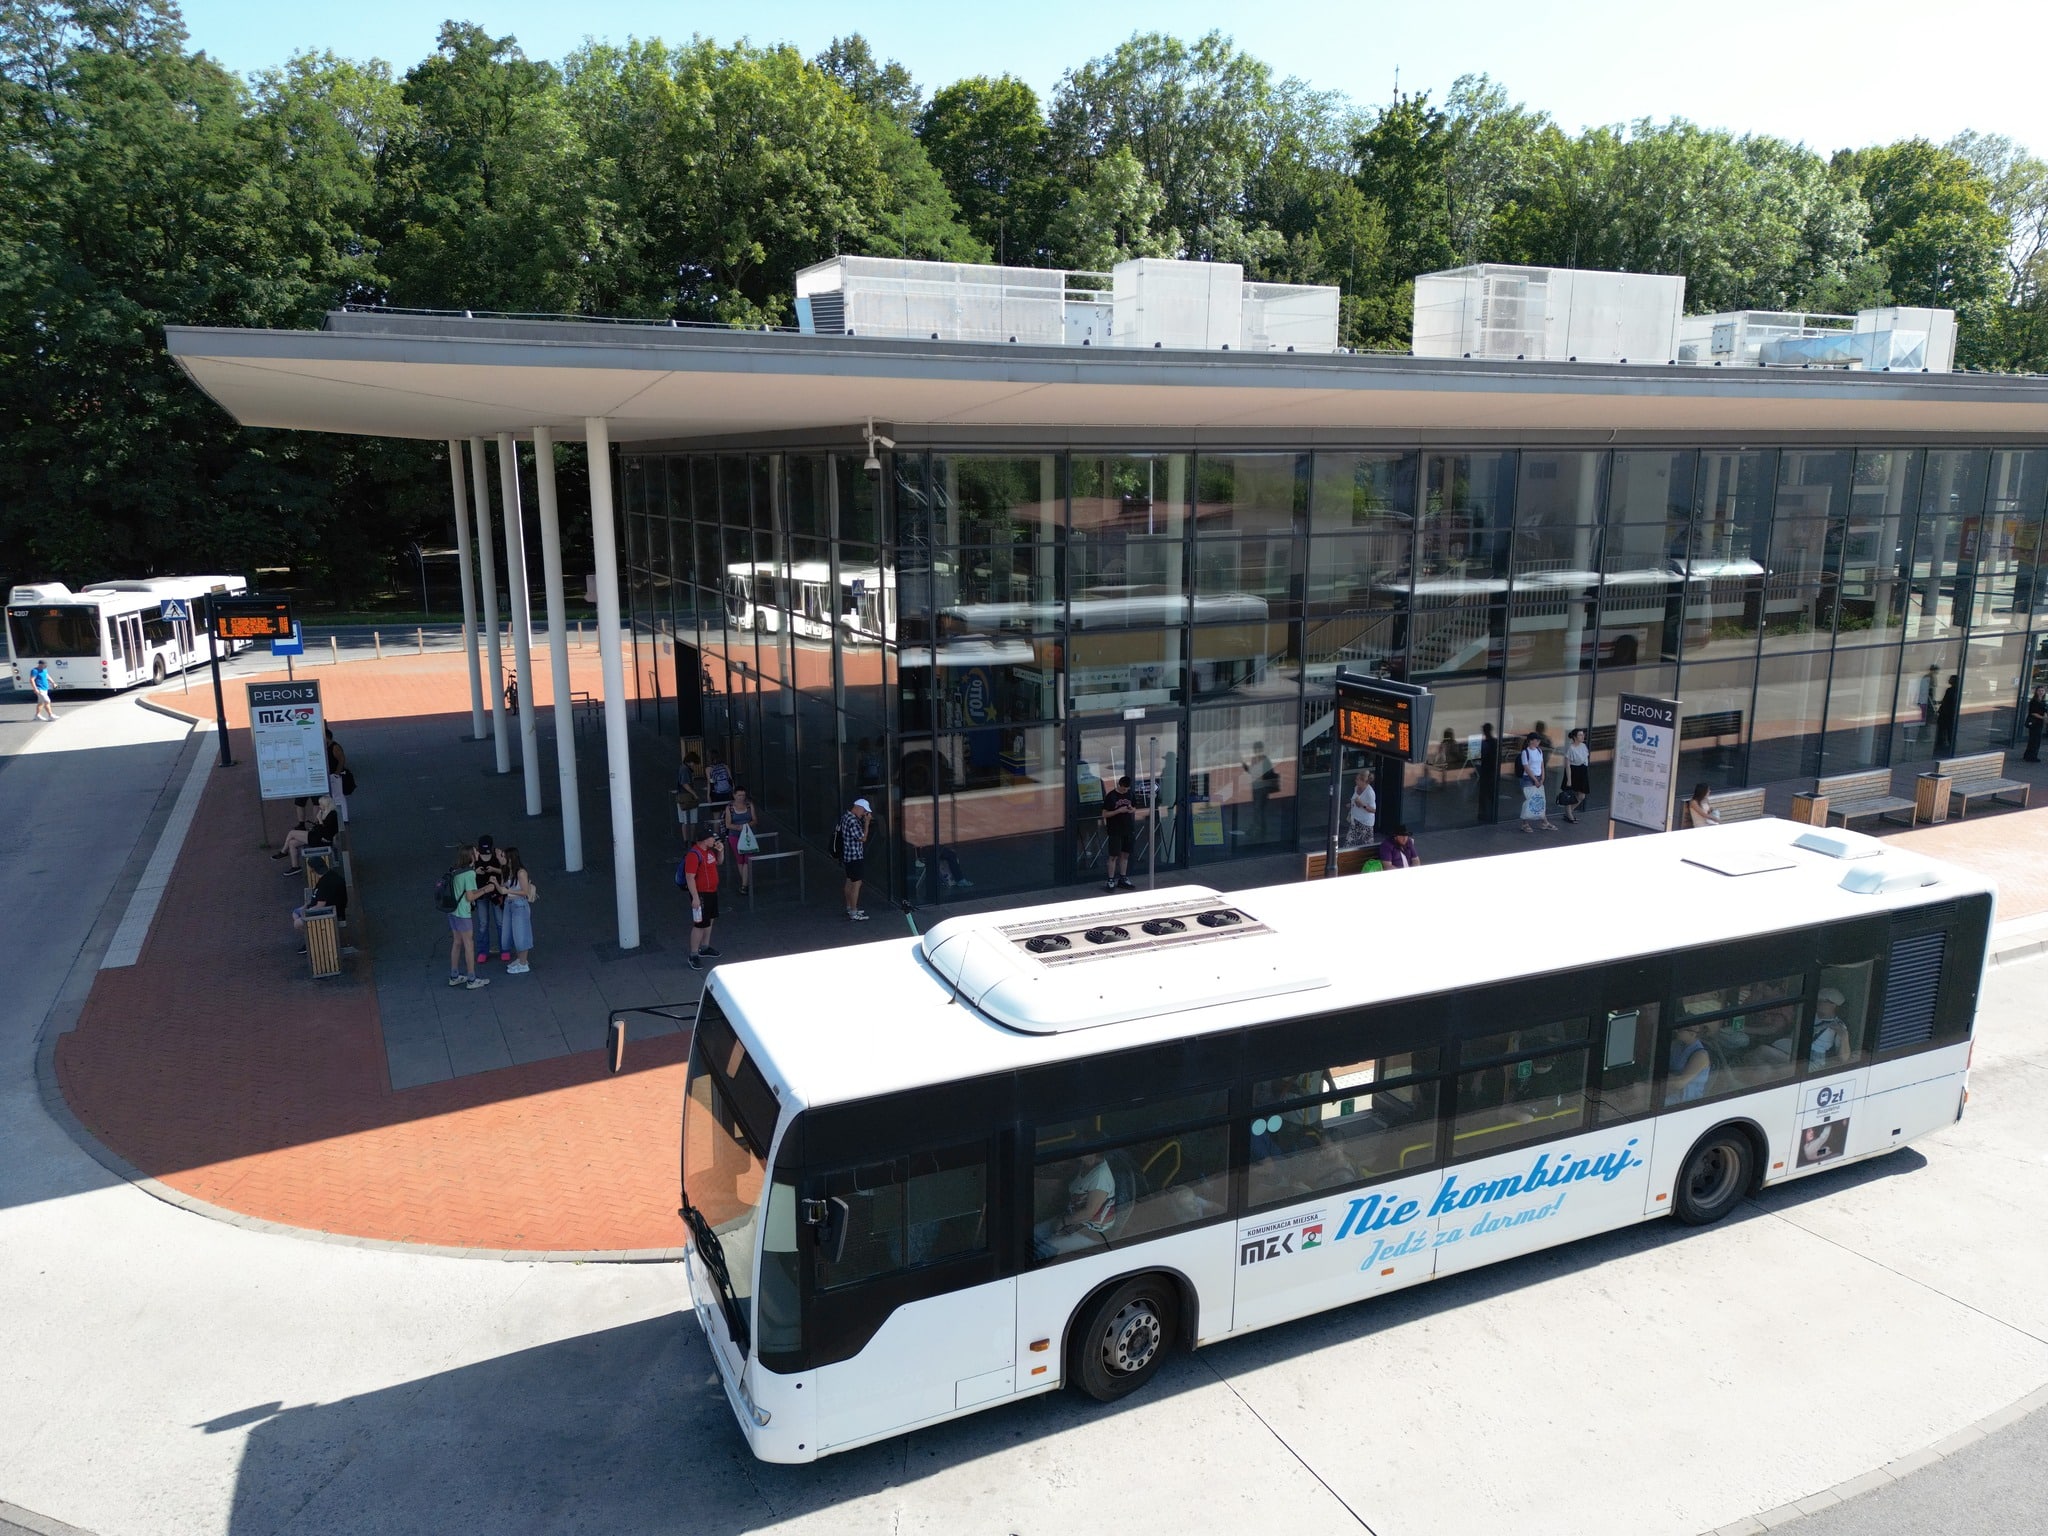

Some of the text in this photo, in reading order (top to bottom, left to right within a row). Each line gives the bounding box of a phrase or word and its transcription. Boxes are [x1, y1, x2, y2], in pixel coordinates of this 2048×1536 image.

[254, 688, 314, 701] PERON 3
[969, 680, 985, 717] LOTTO
[259, 709, 294, 724] MZK
[1623, 703, 1672, 722] PERON 2
[1334, 1138, 1643, 1241] Nie kombinuj.
[1247, 1213, 1319, 1237] KOMUNIKACJA MIEJSKA
[1360, 1192, 1567, 1271] Jedź za darmo!
[1241, 1232, 1294, 1266] MZK
